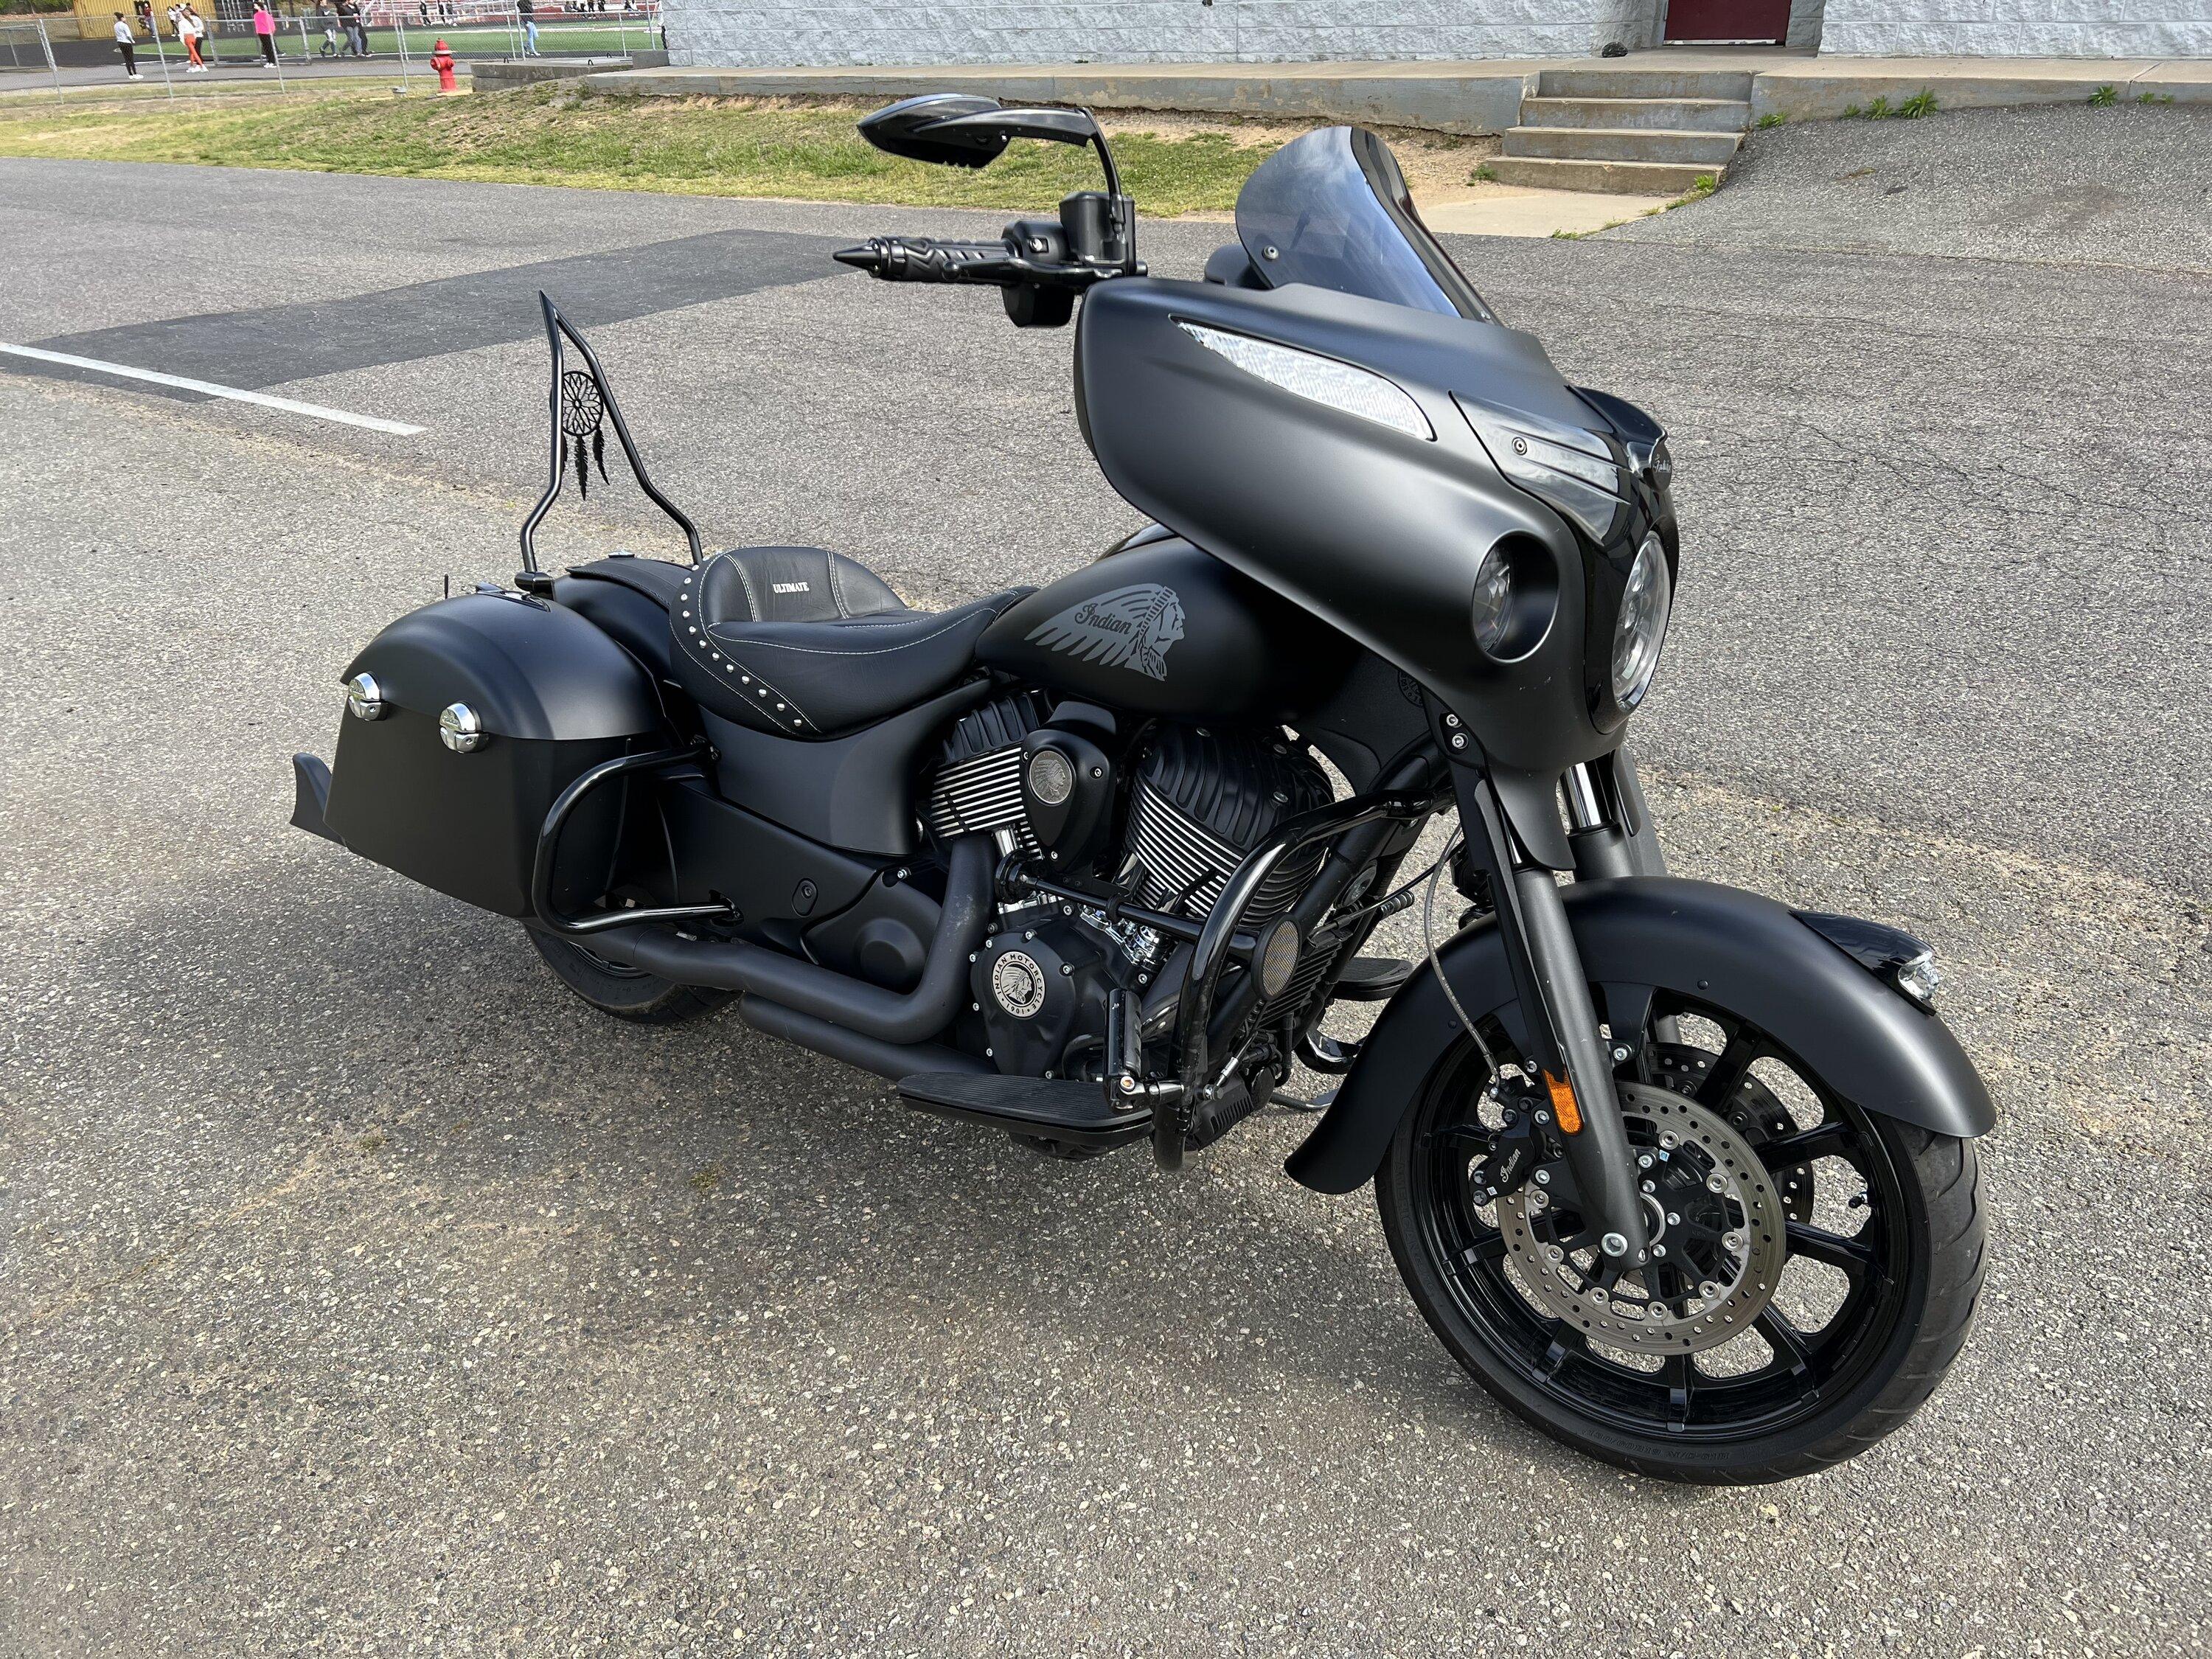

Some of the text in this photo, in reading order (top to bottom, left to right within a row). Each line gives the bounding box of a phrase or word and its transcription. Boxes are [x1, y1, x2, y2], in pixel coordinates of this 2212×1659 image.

[772, 581, 810, 594] ULTIMATE
[1074, 602, 1133, 635] Indian
[994, 953, 1043, 1009] INDIAN MOTORCYCLE
[1006, 1003, 1025, 1015] 1901
[1500, 1148, 1521, 1183] Indian
